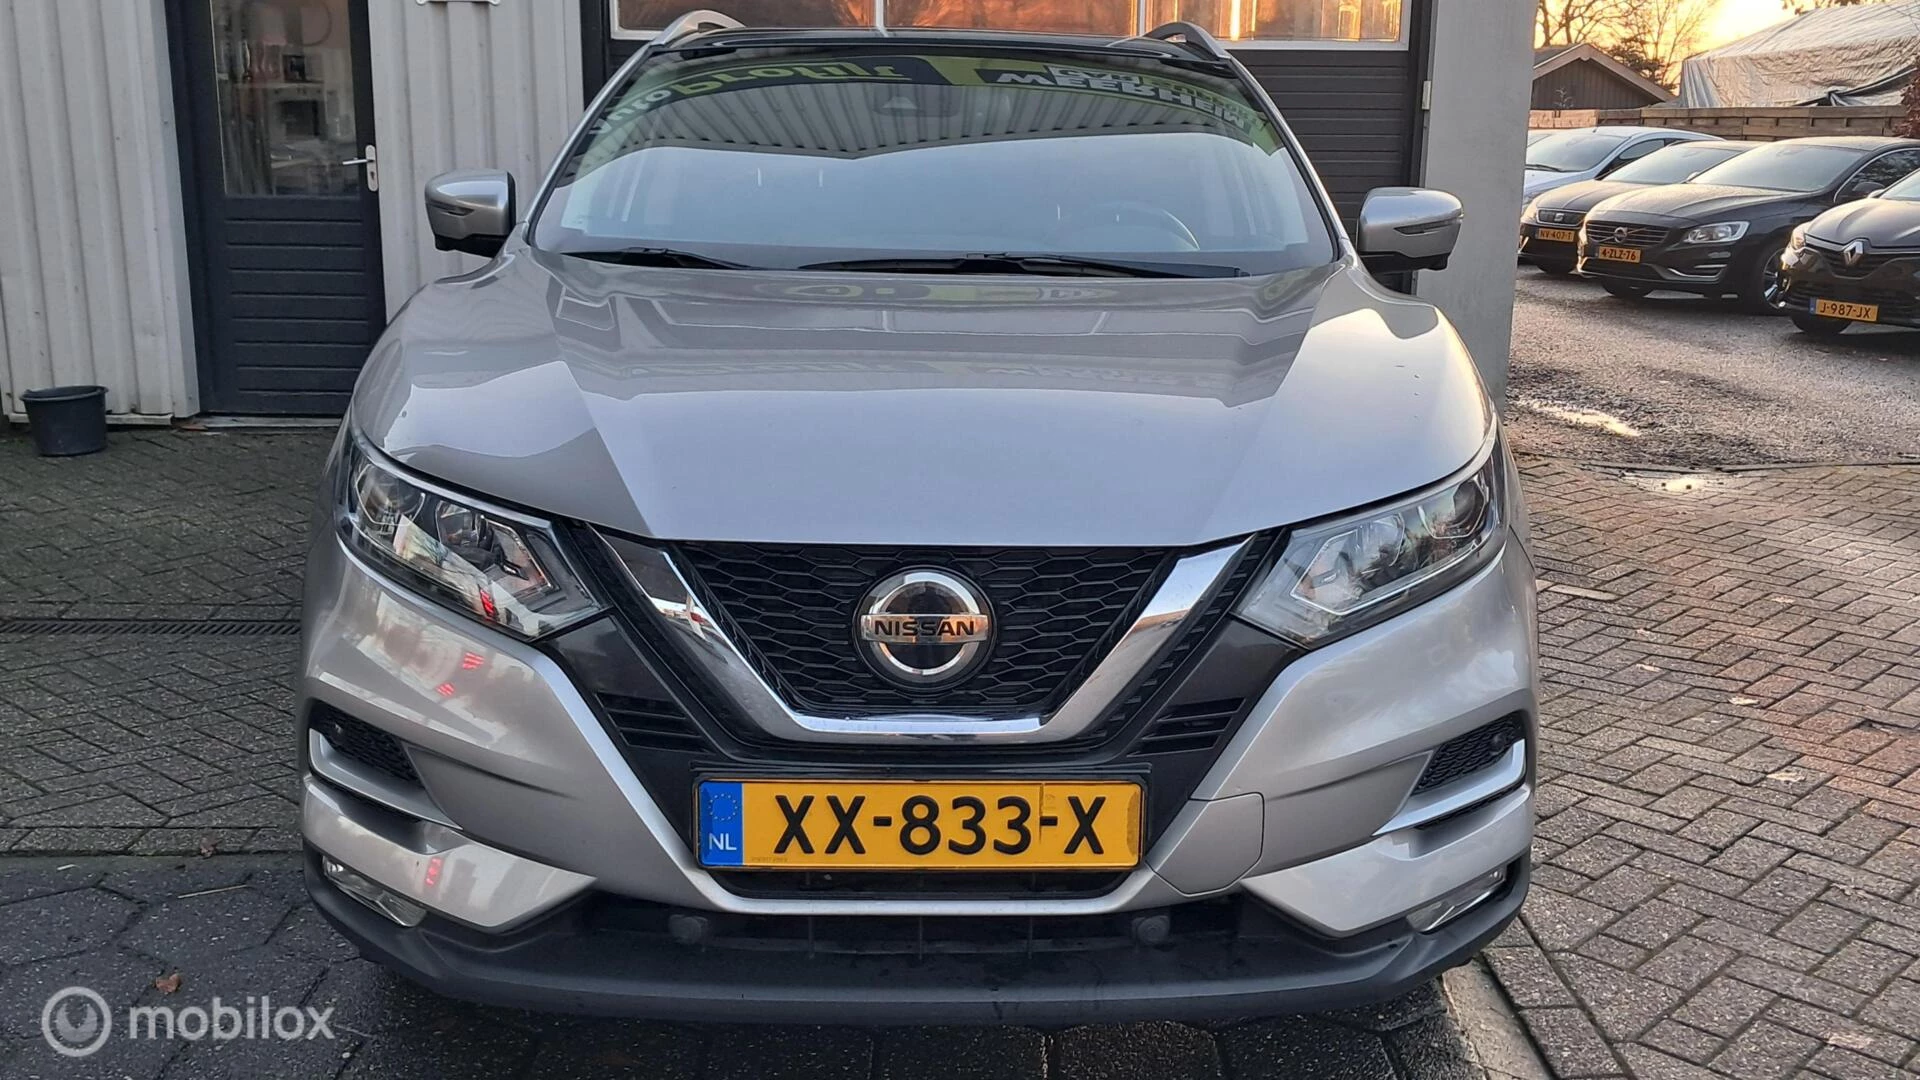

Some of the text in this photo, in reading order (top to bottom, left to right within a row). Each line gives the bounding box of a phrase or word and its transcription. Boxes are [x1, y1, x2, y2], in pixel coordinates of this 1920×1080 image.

[1601, 248, 1637, 261] 4-ZLZ-76
[1820, 302, 1871, 318] J-987-JX
[874, 620, 975, 637] NISSAN
[708, 794, 1107, 855] NL XX-833-X
